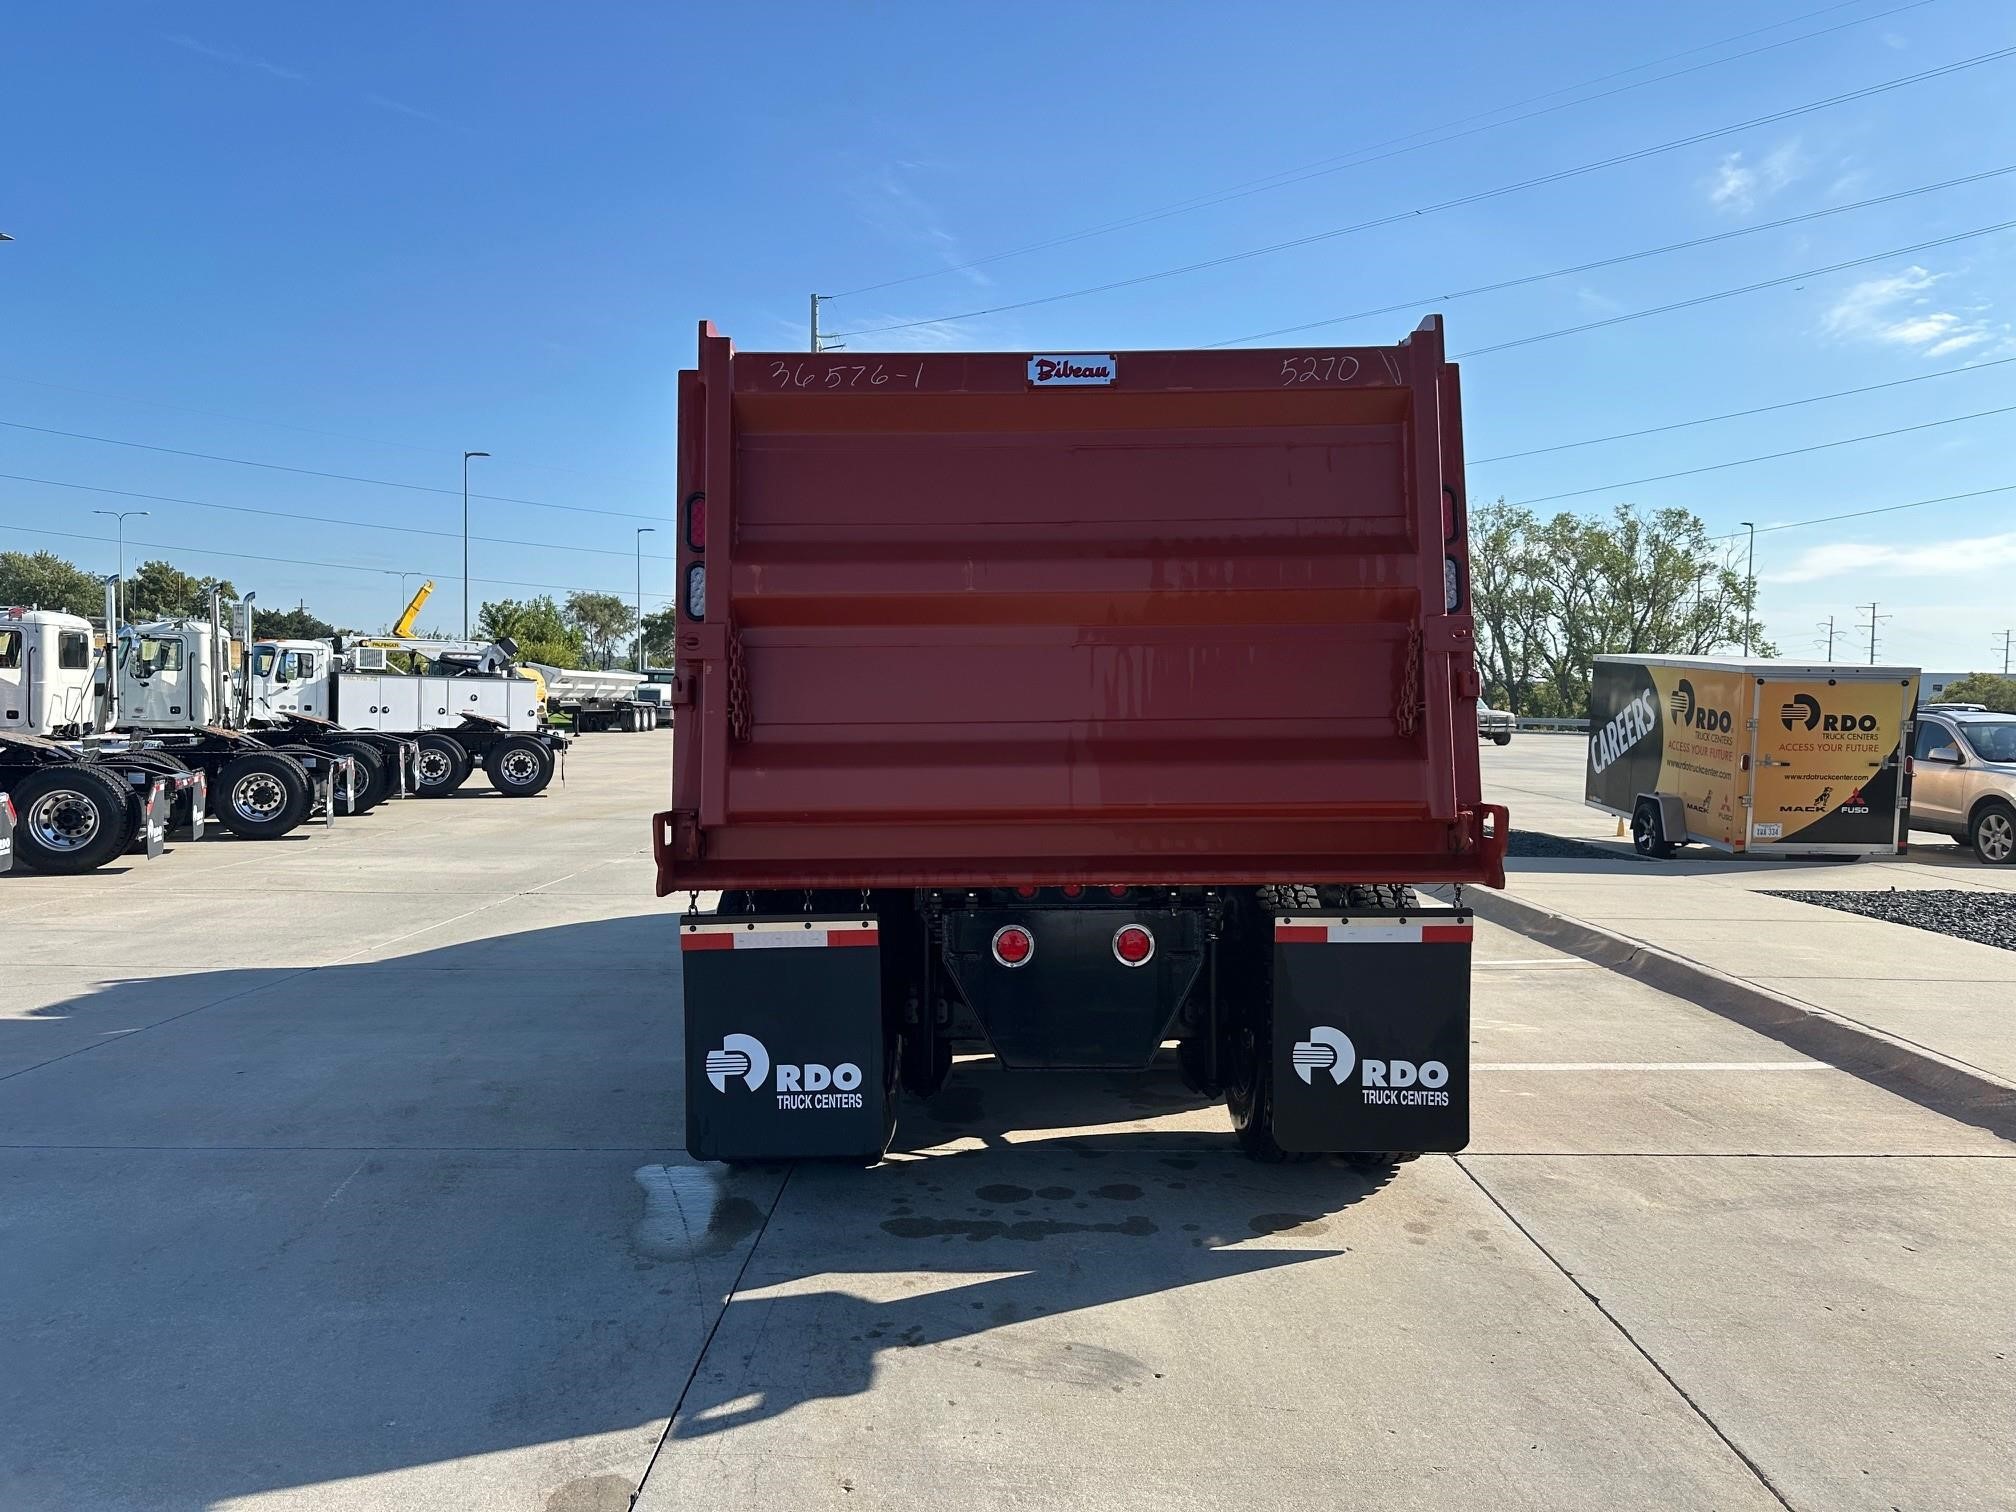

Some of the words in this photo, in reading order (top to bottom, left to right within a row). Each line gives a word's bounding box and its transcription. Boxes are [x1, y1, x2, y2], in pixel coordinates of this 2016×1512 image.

[1034, 358, 1110, 382] Bibeau
[1280, 355, 1360, 386] 5270
[1695, 706, 1732, 733] RDO
[1823, 714, 1877, 732] RDO
[1590, 687, 1656, 775] CAREERS
[1694, 730, 1711, 741] TRUCK
[1711, 733, 1733, 746] CENTERS
[1846, 733, 1879, 741] CENTERS
[1668, 740, 1691, 753] ACCESS
[1691, 742, 1709, 756] YOUR
[1709, 745, 1734, 762] FUTURE
[1779, 743, 1815, 752] ACCESS
[1817, 743, 1843, 752] YOUR
[1846, 744, 1880, 753] FUTURE
[1666, 760, 1732, 780] www.rdotruckcenter.com
[1784, 773, 1869, 781] www.rdotruckcenter.com
[1686, 802, 1710, 814] MACK
[1718, 812, 1733, 822] FUSO
[1841, 806, 1870, 814] FUSO
[776, 1062, 863, 1092] RDO
[1361, 1058, 1449, 1089] RDO
[776, 1094, 813, 1110] TRUCK
[814, 1093, 863, 1109] CENTERS
[1361, 1089, 1398, 1105] TRUCK
[1400, 1090, 1449, 1107] CENTERS
